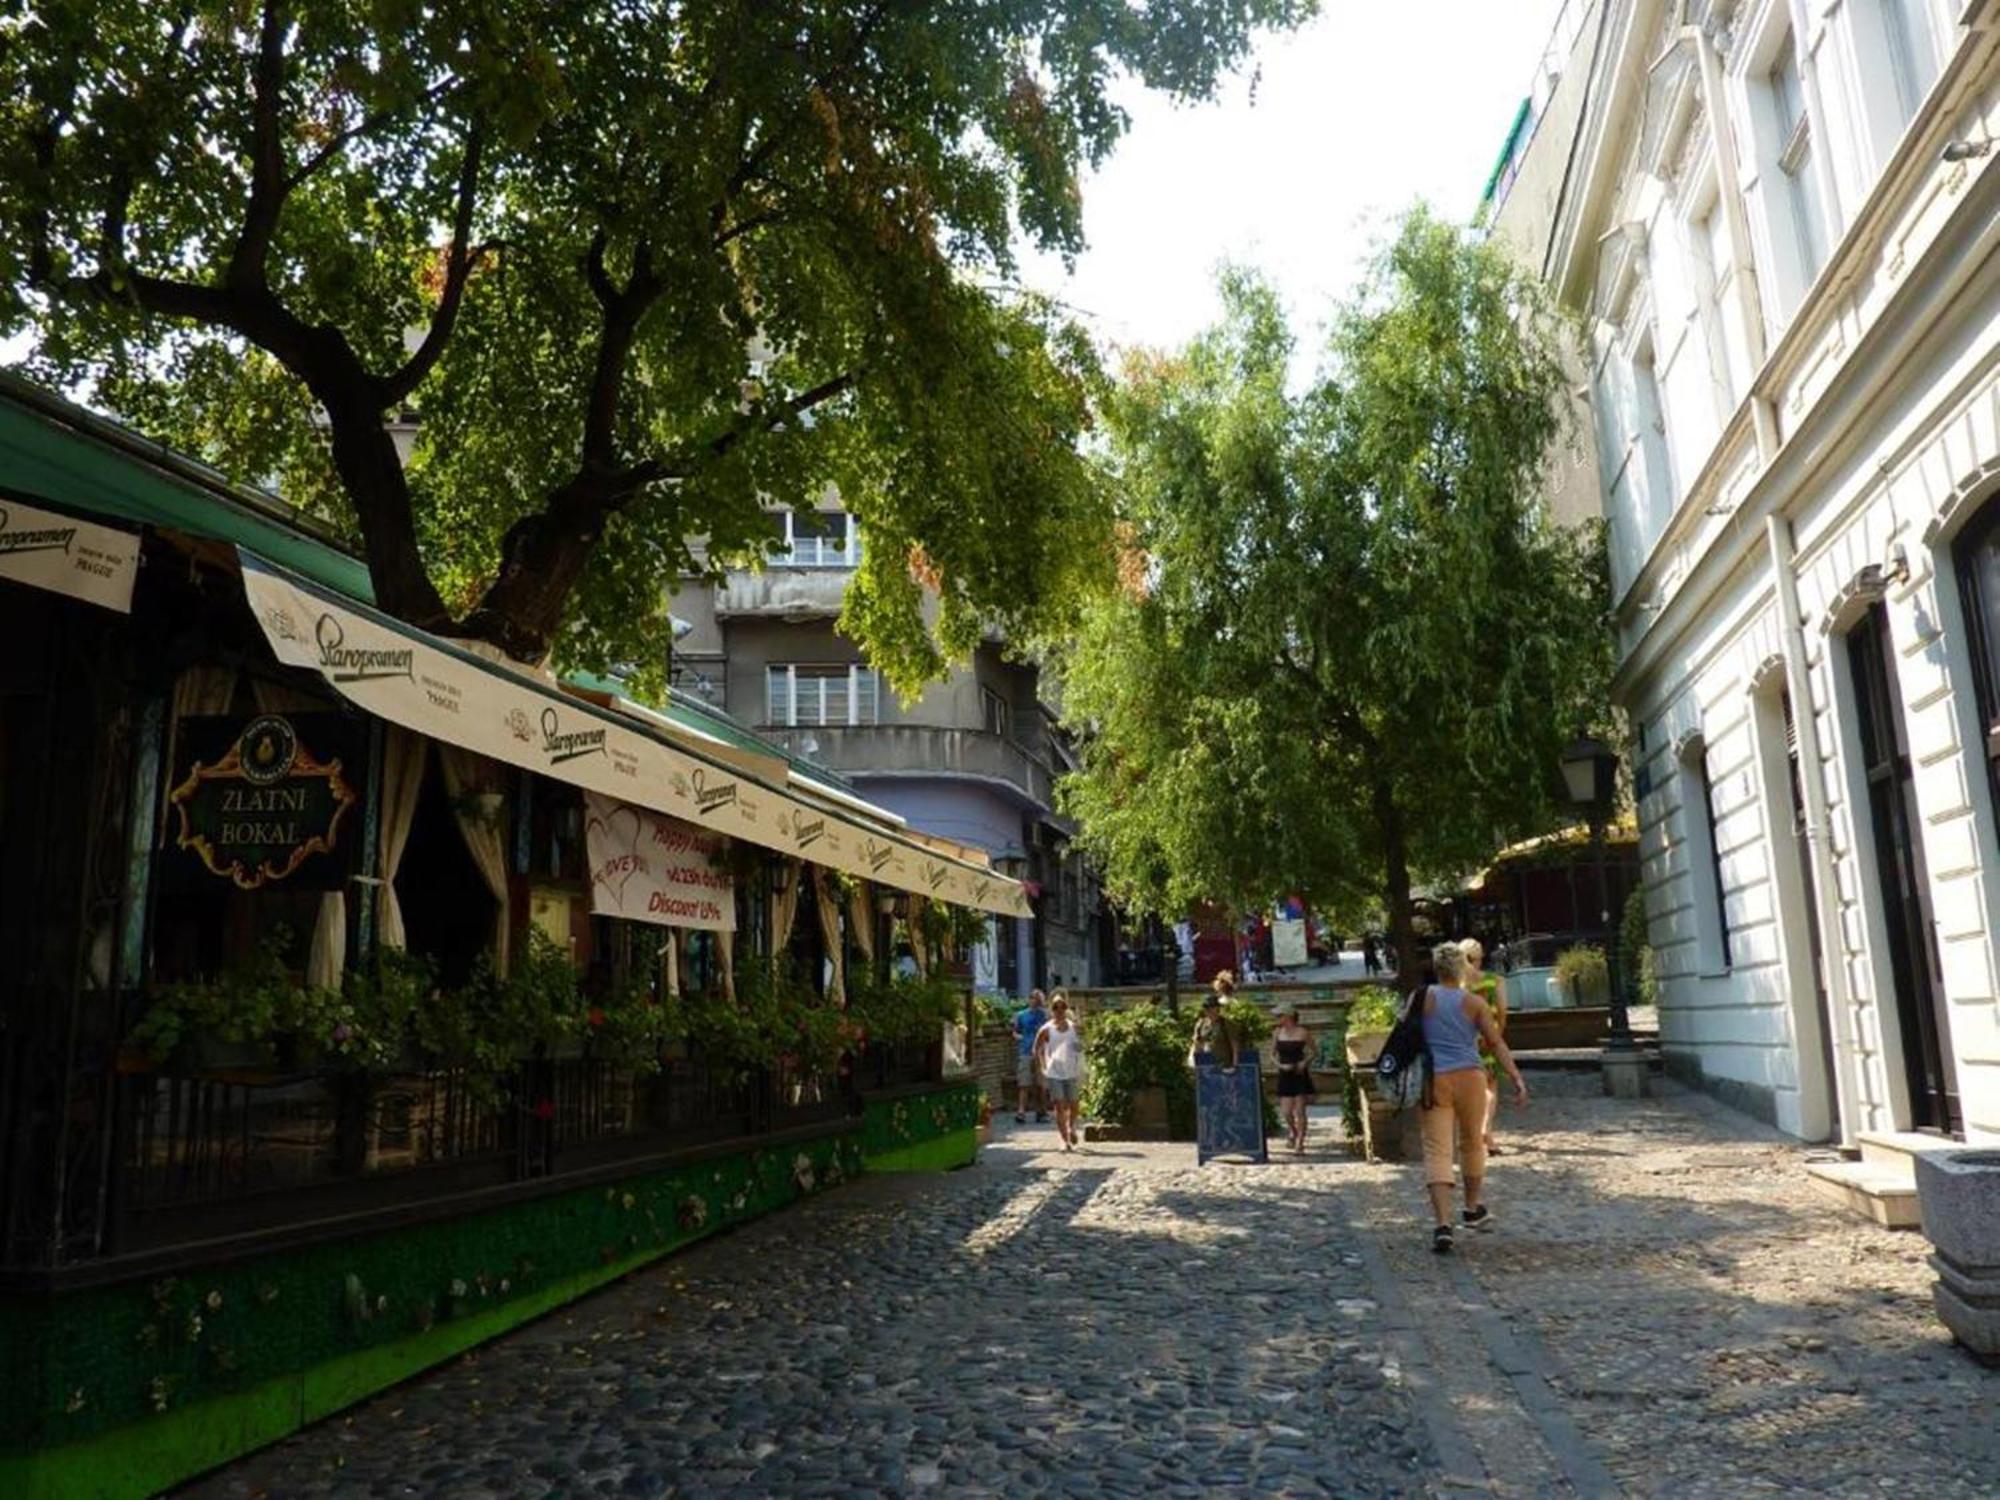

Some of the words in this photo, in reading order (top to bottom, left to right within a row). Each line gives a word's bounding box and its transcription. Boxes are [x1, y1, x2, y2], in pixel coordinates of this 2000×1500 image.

[316, 613, 415, 684] Staropramen
[222, 788, 306, 812] ZLATNI
[221, 821, 300, 845] BOKAL
